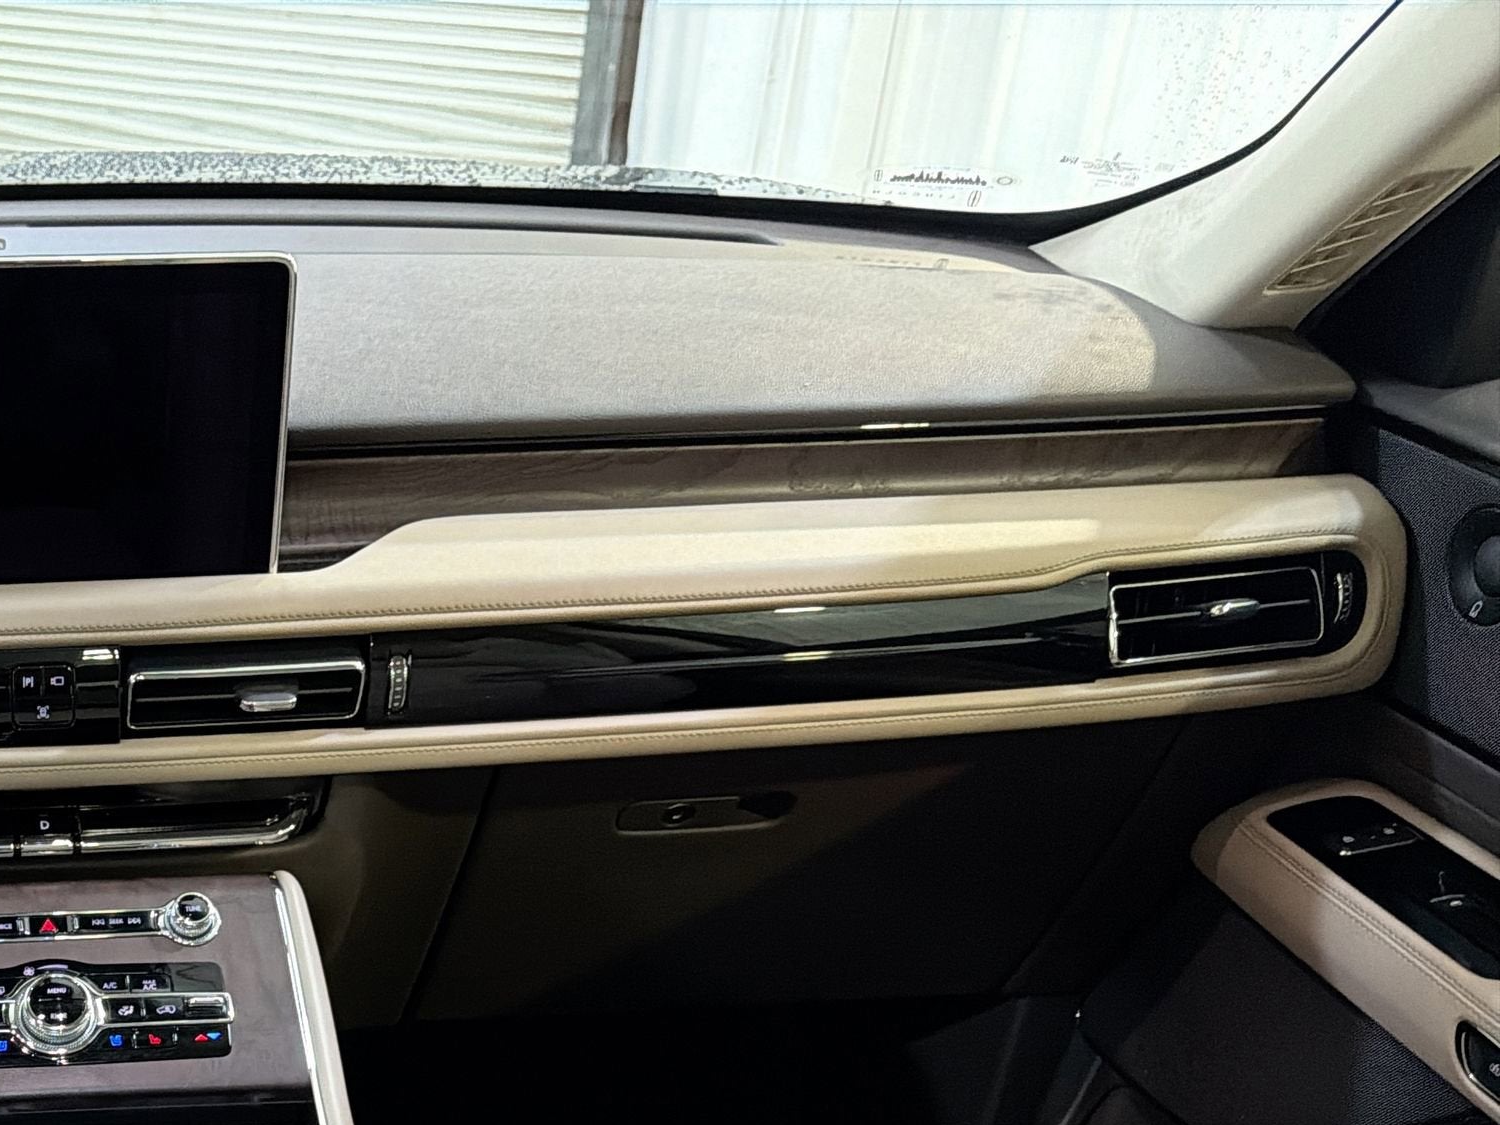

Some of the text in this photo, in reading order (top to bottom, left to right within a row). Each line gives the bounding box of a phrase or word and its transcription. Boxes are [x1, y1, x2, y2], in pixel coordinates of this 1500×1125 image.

[40, 820, 50, 830] D
[102, 981, 118, 990] A/C
[47, 987, 67, 995] MENU
